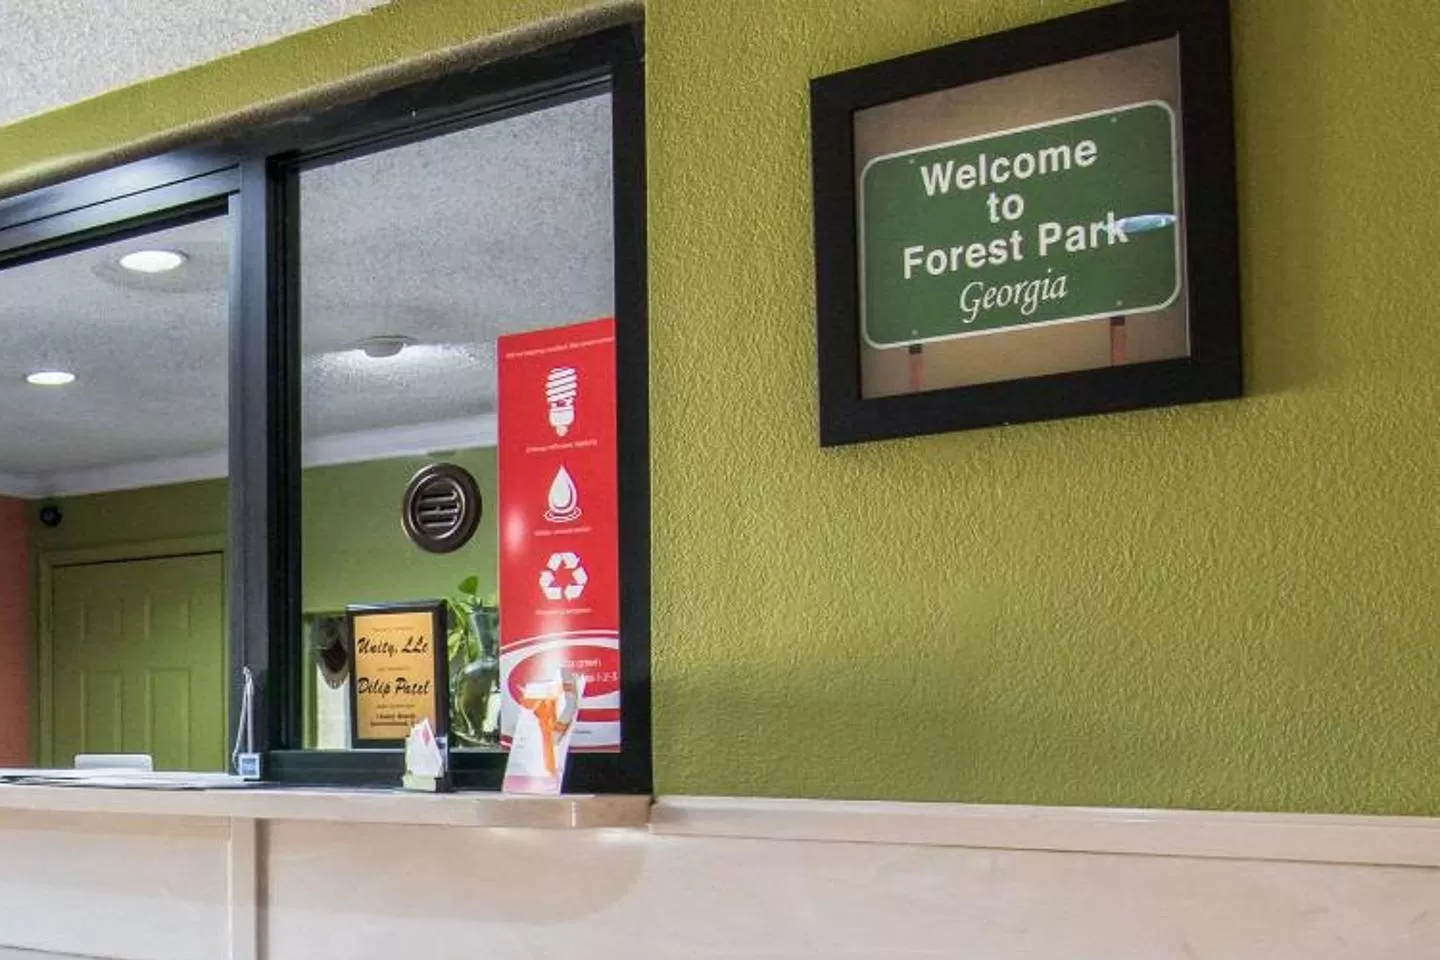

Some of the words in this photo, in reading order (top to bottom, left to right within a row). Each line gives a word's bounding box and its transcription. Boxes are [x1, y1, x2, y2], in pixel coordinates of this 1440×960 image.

[919, 138, 1099, 197] Welcome
[986, 191, 1025, 224] to
[903, 230, 1024, 280] Forest
[1038, 211, 1130, 257] Park
[959, 267, 1069, 323] Georgia
